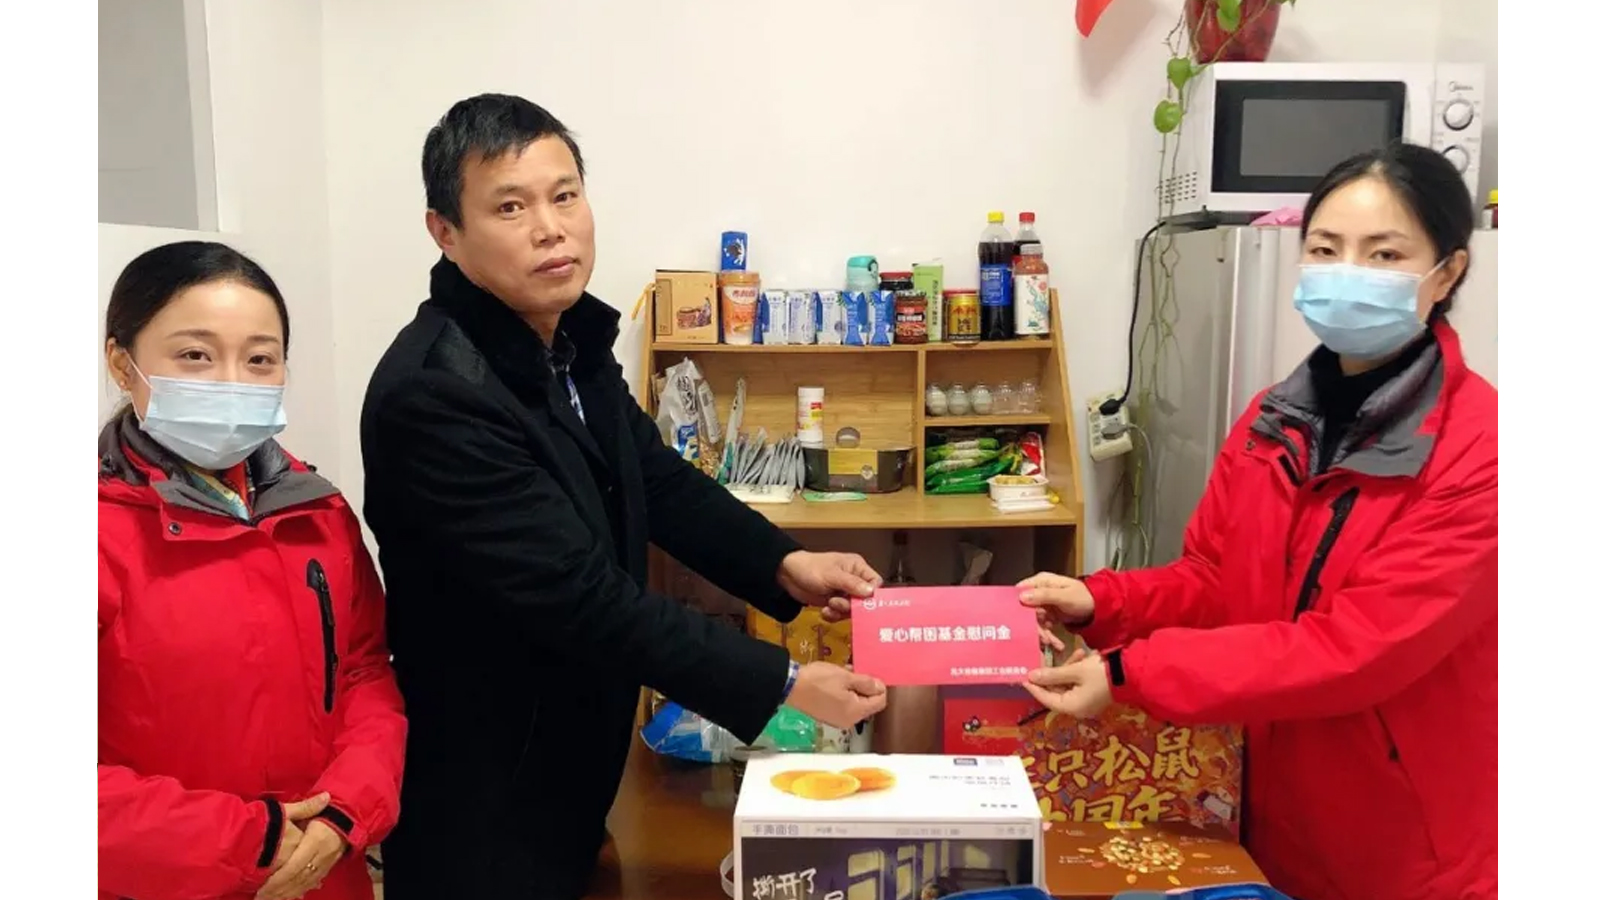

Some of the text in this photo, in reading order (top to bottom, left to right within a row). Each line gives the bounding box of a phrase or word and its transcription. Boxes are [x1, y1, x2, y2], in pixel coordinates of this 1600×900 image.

[879, 625, 1011, 643] 爱心帮困基金慰问金
